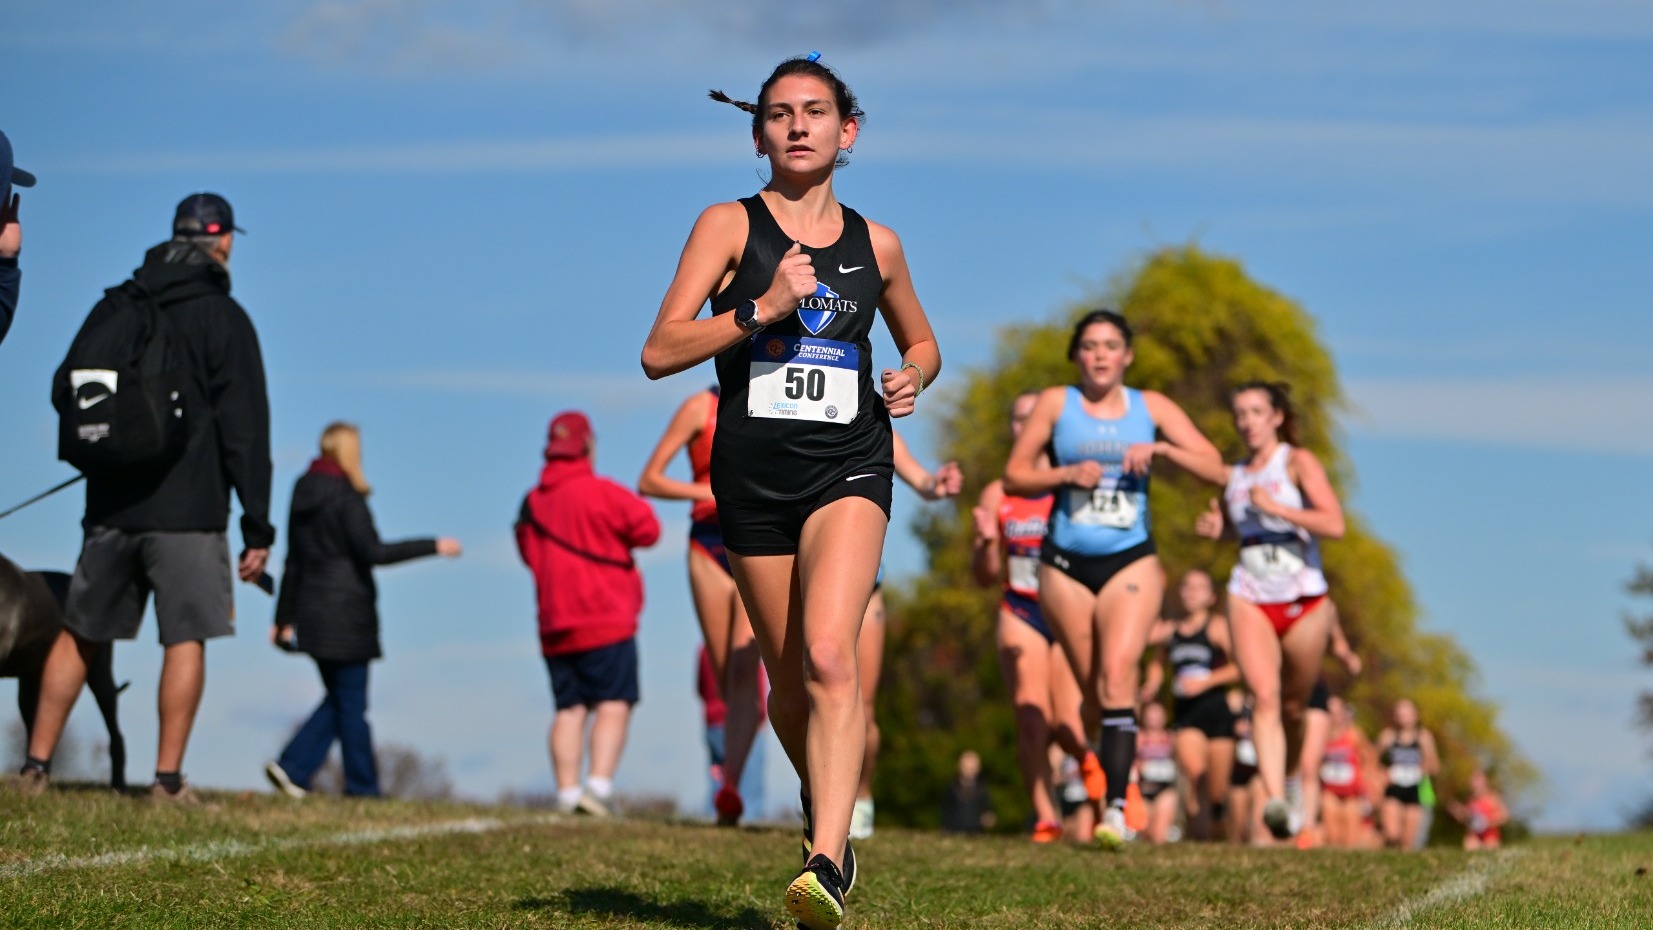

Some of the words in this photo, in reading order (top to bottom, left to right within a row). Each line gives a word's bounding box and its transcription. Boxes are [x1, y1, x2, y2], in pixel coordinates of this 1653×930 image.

[800, 297, 858, 312] LOMATS
[794, 343, 845, 357] CENTENNIAL
[798, 352, 839, 361] CONFERENCE
[785, 367, 826, 402] 50
